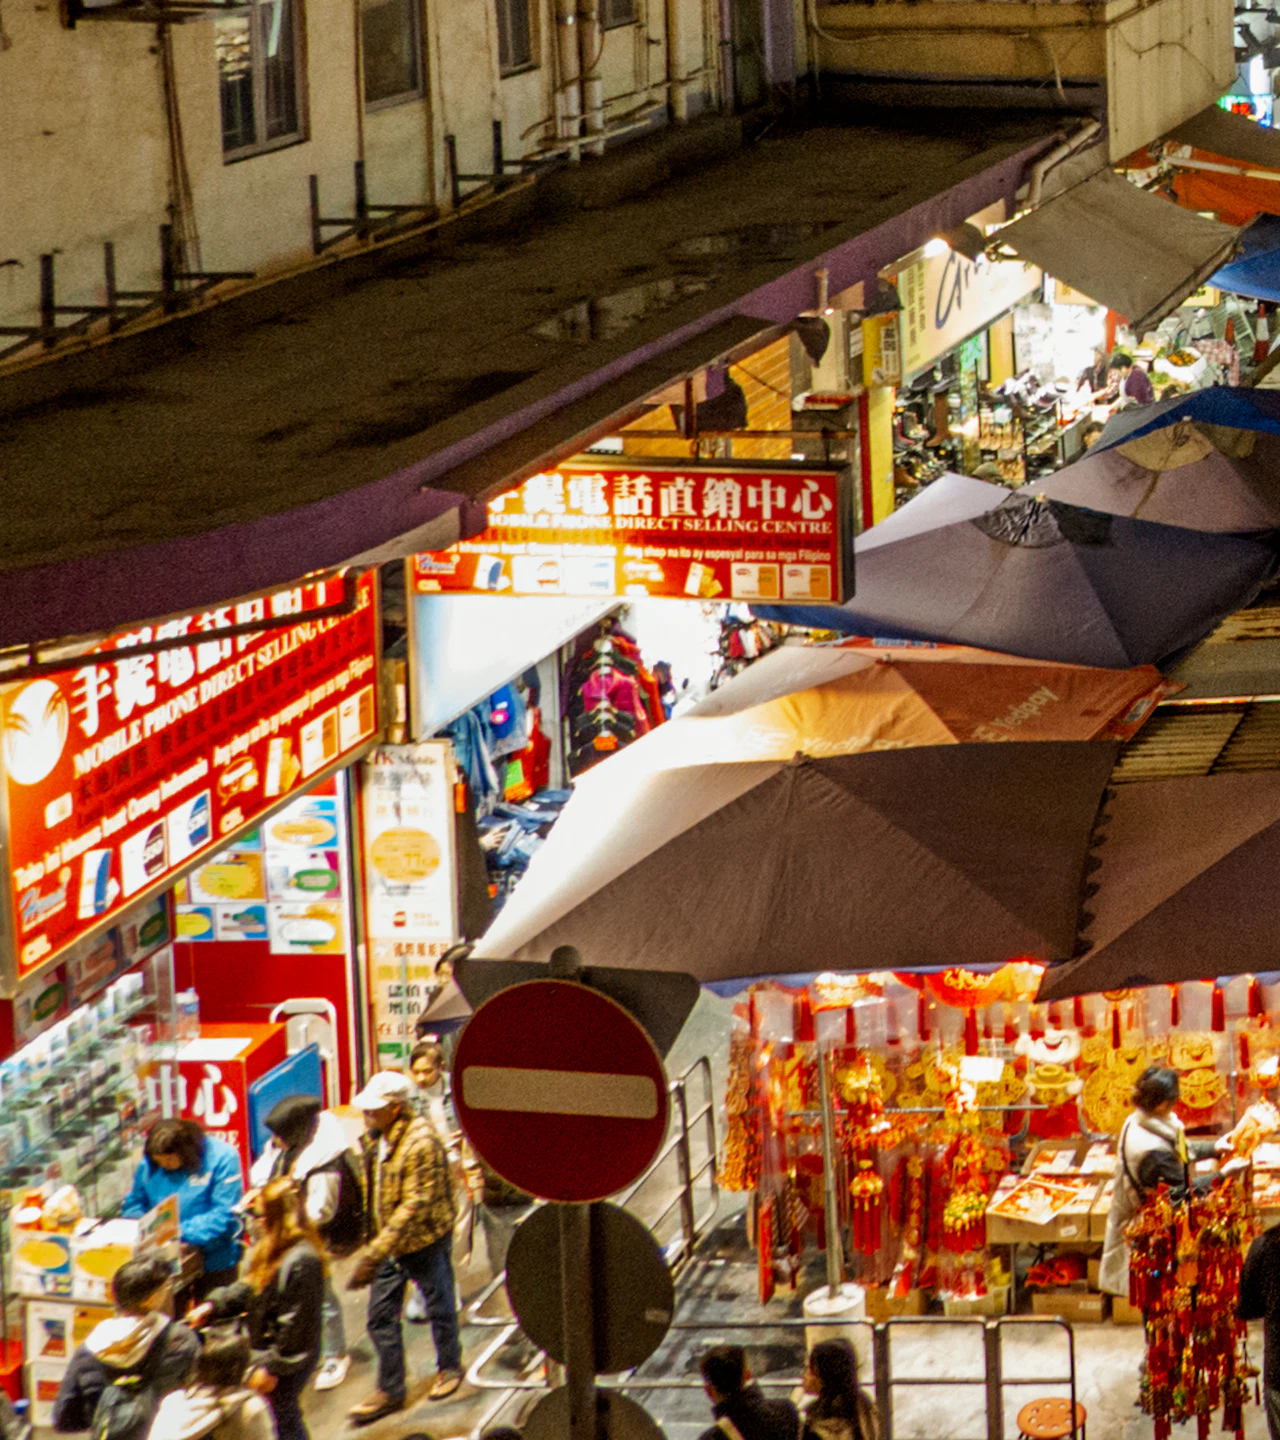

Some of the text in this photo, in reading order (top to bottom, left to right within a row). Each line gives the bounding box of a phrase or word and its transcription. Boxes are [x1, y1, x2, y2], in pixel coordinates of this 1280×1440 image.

[615, 516, 682, 531] DIRECT
[683, 518, 759, 533] SELLING
[761, 519, 833, 534] CENTRE
[644, 545, 666, 560] shop
[745, 549, 764, 562] para
[798, 549, 832, 563] Filipino
[143, 687, 198, 737] PHONE
[200, 653, 256, 705] DIRECT
[255, 617, 318, 671] SELLING
[145, 1062, 239, 1127] 中心
